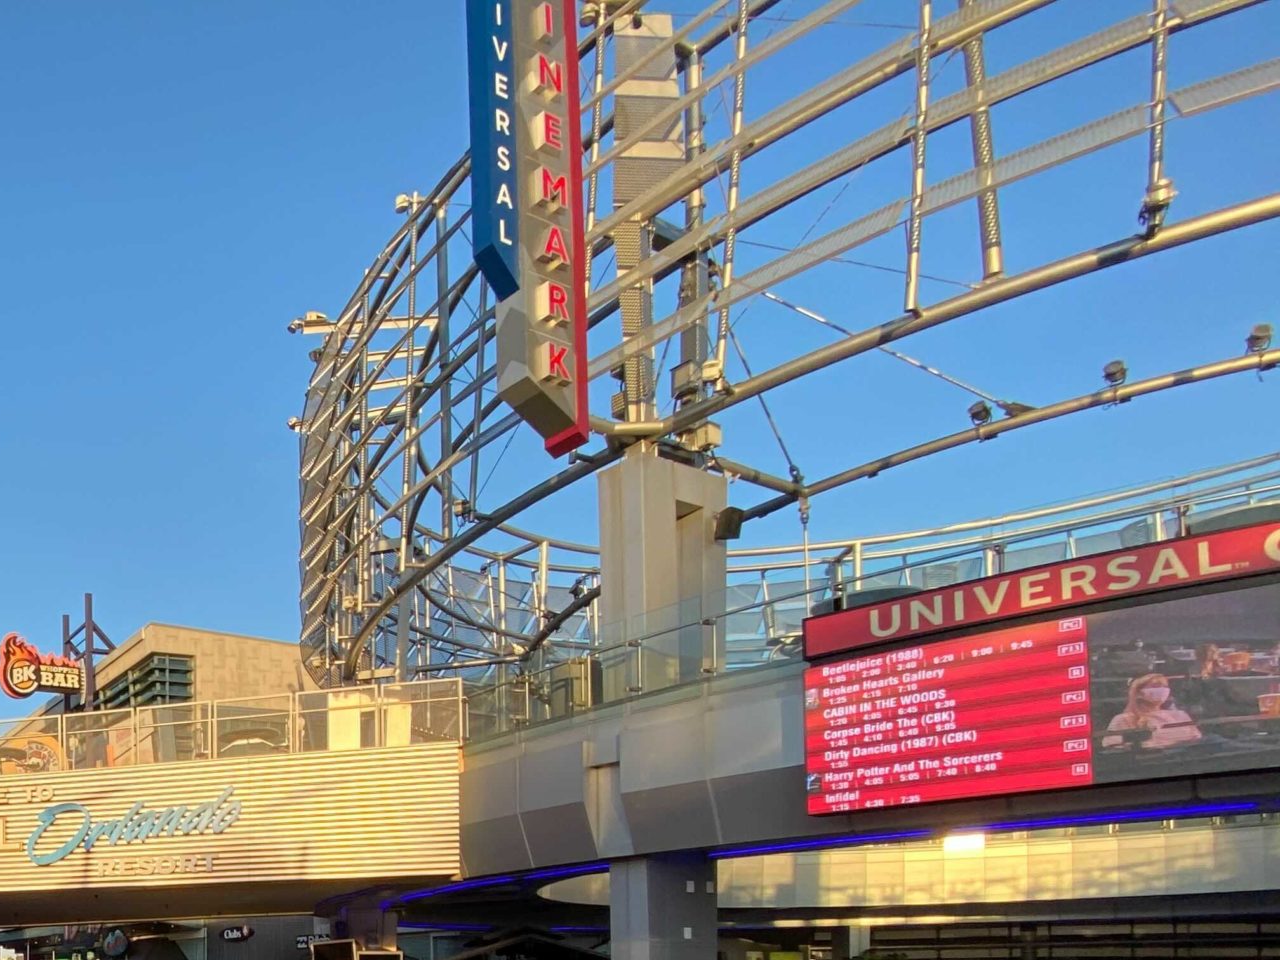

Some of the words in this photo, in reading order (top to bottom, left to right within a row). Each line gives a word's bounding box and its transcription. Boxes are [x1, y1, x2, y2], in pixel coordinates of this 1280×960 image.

[11, 664, 36, 685] BK
[40, 671, 80, 689] BAR
[823, 656, 884, 677] Beetlejuice
[823, 683, 859, 698] Broken
[863, 677, 899, 690] Hearts
[902, 668, 945, 684] Gallery
[823, 703, 857, 719] CABIN
[859, 701, 871, 712] IN
[875, 697, 897, 709] THE
[900, 689, 946, 706] WOODS
[824, 726, 861, 740] Corpse
[864, 721, 893, 734] Bride
[896, 717, 918, 729] The
[921, 710, 955, 726] (CBK)
[824, 748, 850, 762] Dirty
[853, 741, 898, 758] Dancing
[901, 737, 939, 752] (1987)
[942, 730, 977, 745] (CBK)
[825, 769, 854, 783] Harry
[857, 765, 890, 778] Potter
[893, 760, 915, 773] And
[918, 758, 940, 770] The
[943, 751, 1003, 767] Sorcerers
[23, 785, 55, 803] TO
[825, 790, 860, 804] Infidel
[26, 784, 242, 866] Orlando
[96, 852, 220, 877] RESORT
